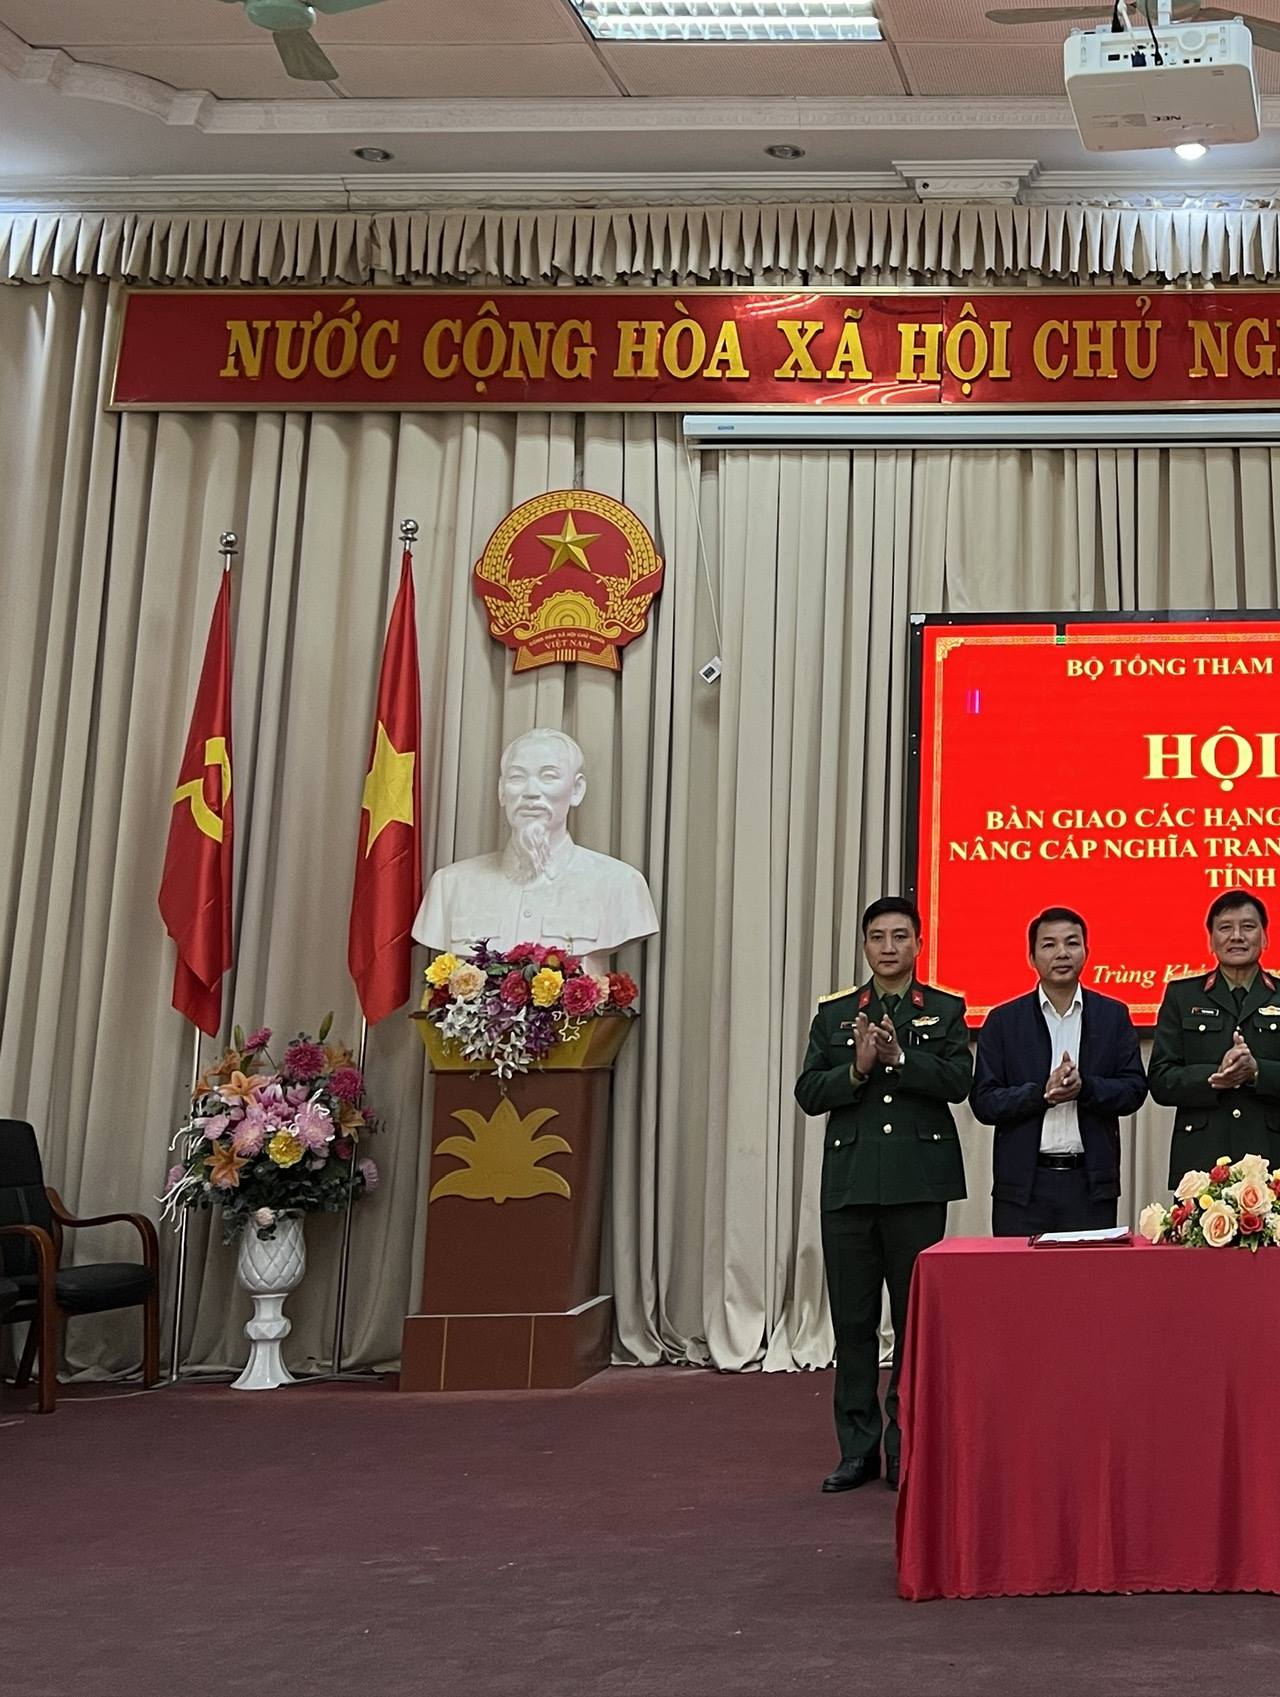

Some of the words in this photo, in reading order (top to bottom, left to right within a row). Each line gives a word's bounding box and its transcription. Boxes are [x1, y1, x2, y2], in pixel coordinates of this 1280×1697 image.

[219, 297, 399, 378] NƯỚC
[422, 301, 598, 394] CỘNG
[613, 299, 750, 379] HÒA
[773, 307, 871, 381] XÃ
[895, 301, 1013, 395] HỘI
[1032, 297, 1161, 379] CHỦ
[1068, 657, 1104, 680] BỘ
[1111, 655, 1185, 676] TỔNG
[1193, 658, 1272, 675] THAM
[1144, 726, 1280, 791] HỘI
[987, 805, 1044, 829] BÀN
[1052, 809, 1126, 828] GIAO
[1135, 803, 1195, 827] CÁC
[950, 836, 1031, 860] NÂNG
[1040, 835, 1097, 859] CẤP
[1104, 834, 1198, 858] NGHĨA
[1205, 863, 1276, 888] TỈNH
[1093, 964, 1157, 989] Trùng
